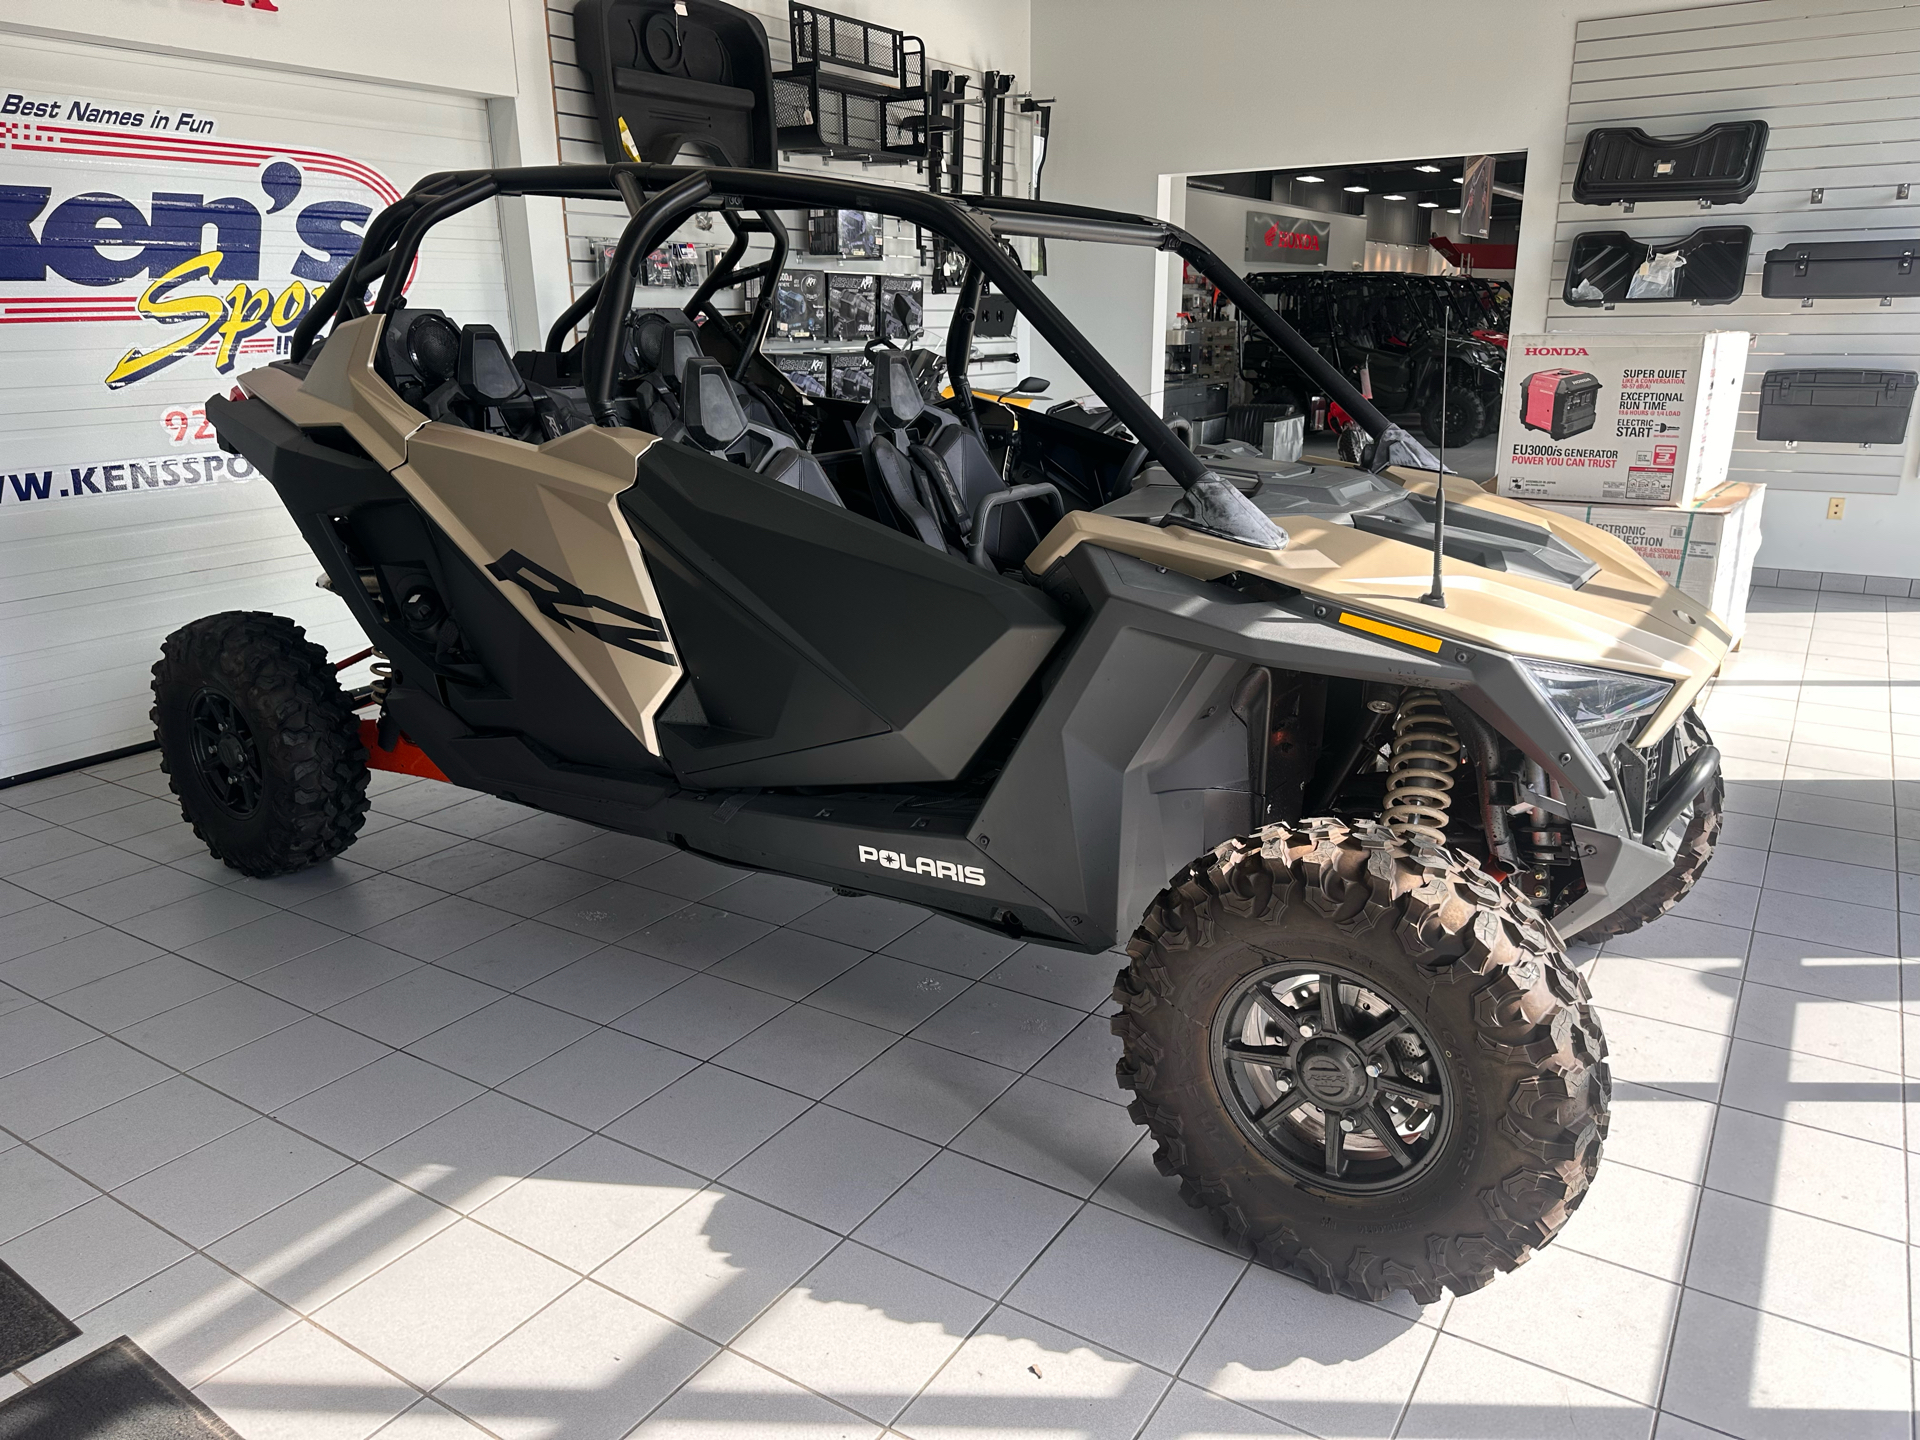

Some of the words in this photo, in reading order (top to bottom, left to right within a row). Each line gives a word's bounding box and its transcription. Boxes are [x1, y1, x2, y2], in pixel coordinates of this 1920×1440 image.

[1, 94, 61, 119] Best
[67, 101, 144, 127] Names
[150, 110, 169, 129] in
[175, 113, 214, 134] Fun
[1278, 230, 1320, 251] HONDA
[1524, 347, 1590, 356] HONDA
[1623, 369, 1655, 378] SUPER
[1657, 369, 1687, 379] QUIET
[1620, 392, 1684, 402] EXCEPTIONAL
[1619, 401, 1641, 410] RUN
[1643, 401, 1667, 410] TIME
[1617, 419, 1654, 427] ELECTRIC
[1616, 427, 1653, 438] START
[1513, 444, 1562, 456] EU3000is
[1564, 448, 1618, 459] GENERATOR
[1511, 456, 1544, 465] POWER
[1545, 457, 1564, 466] YOU
[1565, 458, 1585, 467] CAN
[1587, 459, 1617, 468] TRUST
[859, 845, 987, 886] POLARIS
[1440, 1026, 1481, 1177] CARNIVORE
